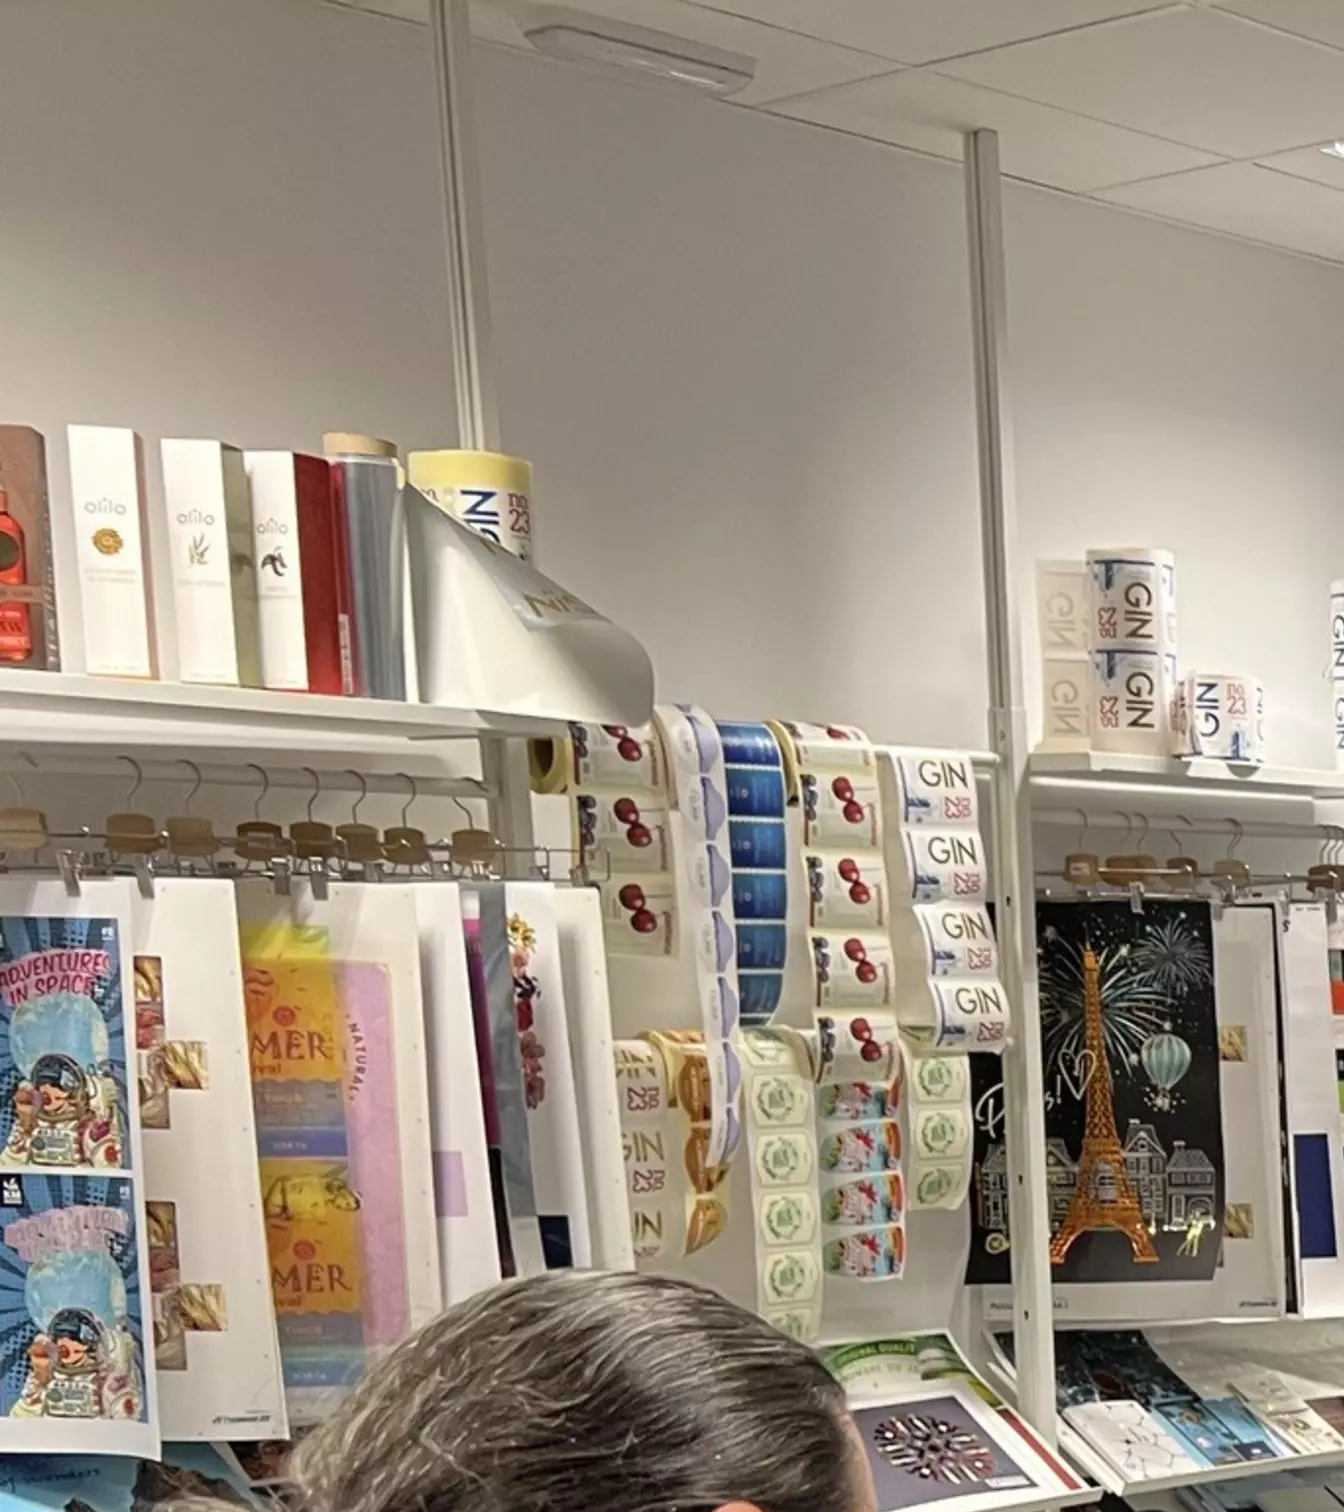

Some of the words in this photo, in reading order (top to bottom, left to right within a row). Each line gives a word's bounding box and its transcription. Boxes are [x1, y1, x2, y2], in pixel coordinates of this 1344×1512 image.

[510, 509, 531, 534] 23
[1124, 582, 1153, 640] GIN
[1125, 671, 1155, 729] GIN
[1196, 683, 1220, 737] GIN
[918, 760, 968, 788] GIN
[928, 837, 977, 865] GIN
[941, 912, 988, 939] GIN
[10, 983, 28, 1006] IN
[955, 987, 1003, 1014] GIN
[626, 1086, 647, 1112] 23
[632, 1169, 652, 1194] 23
